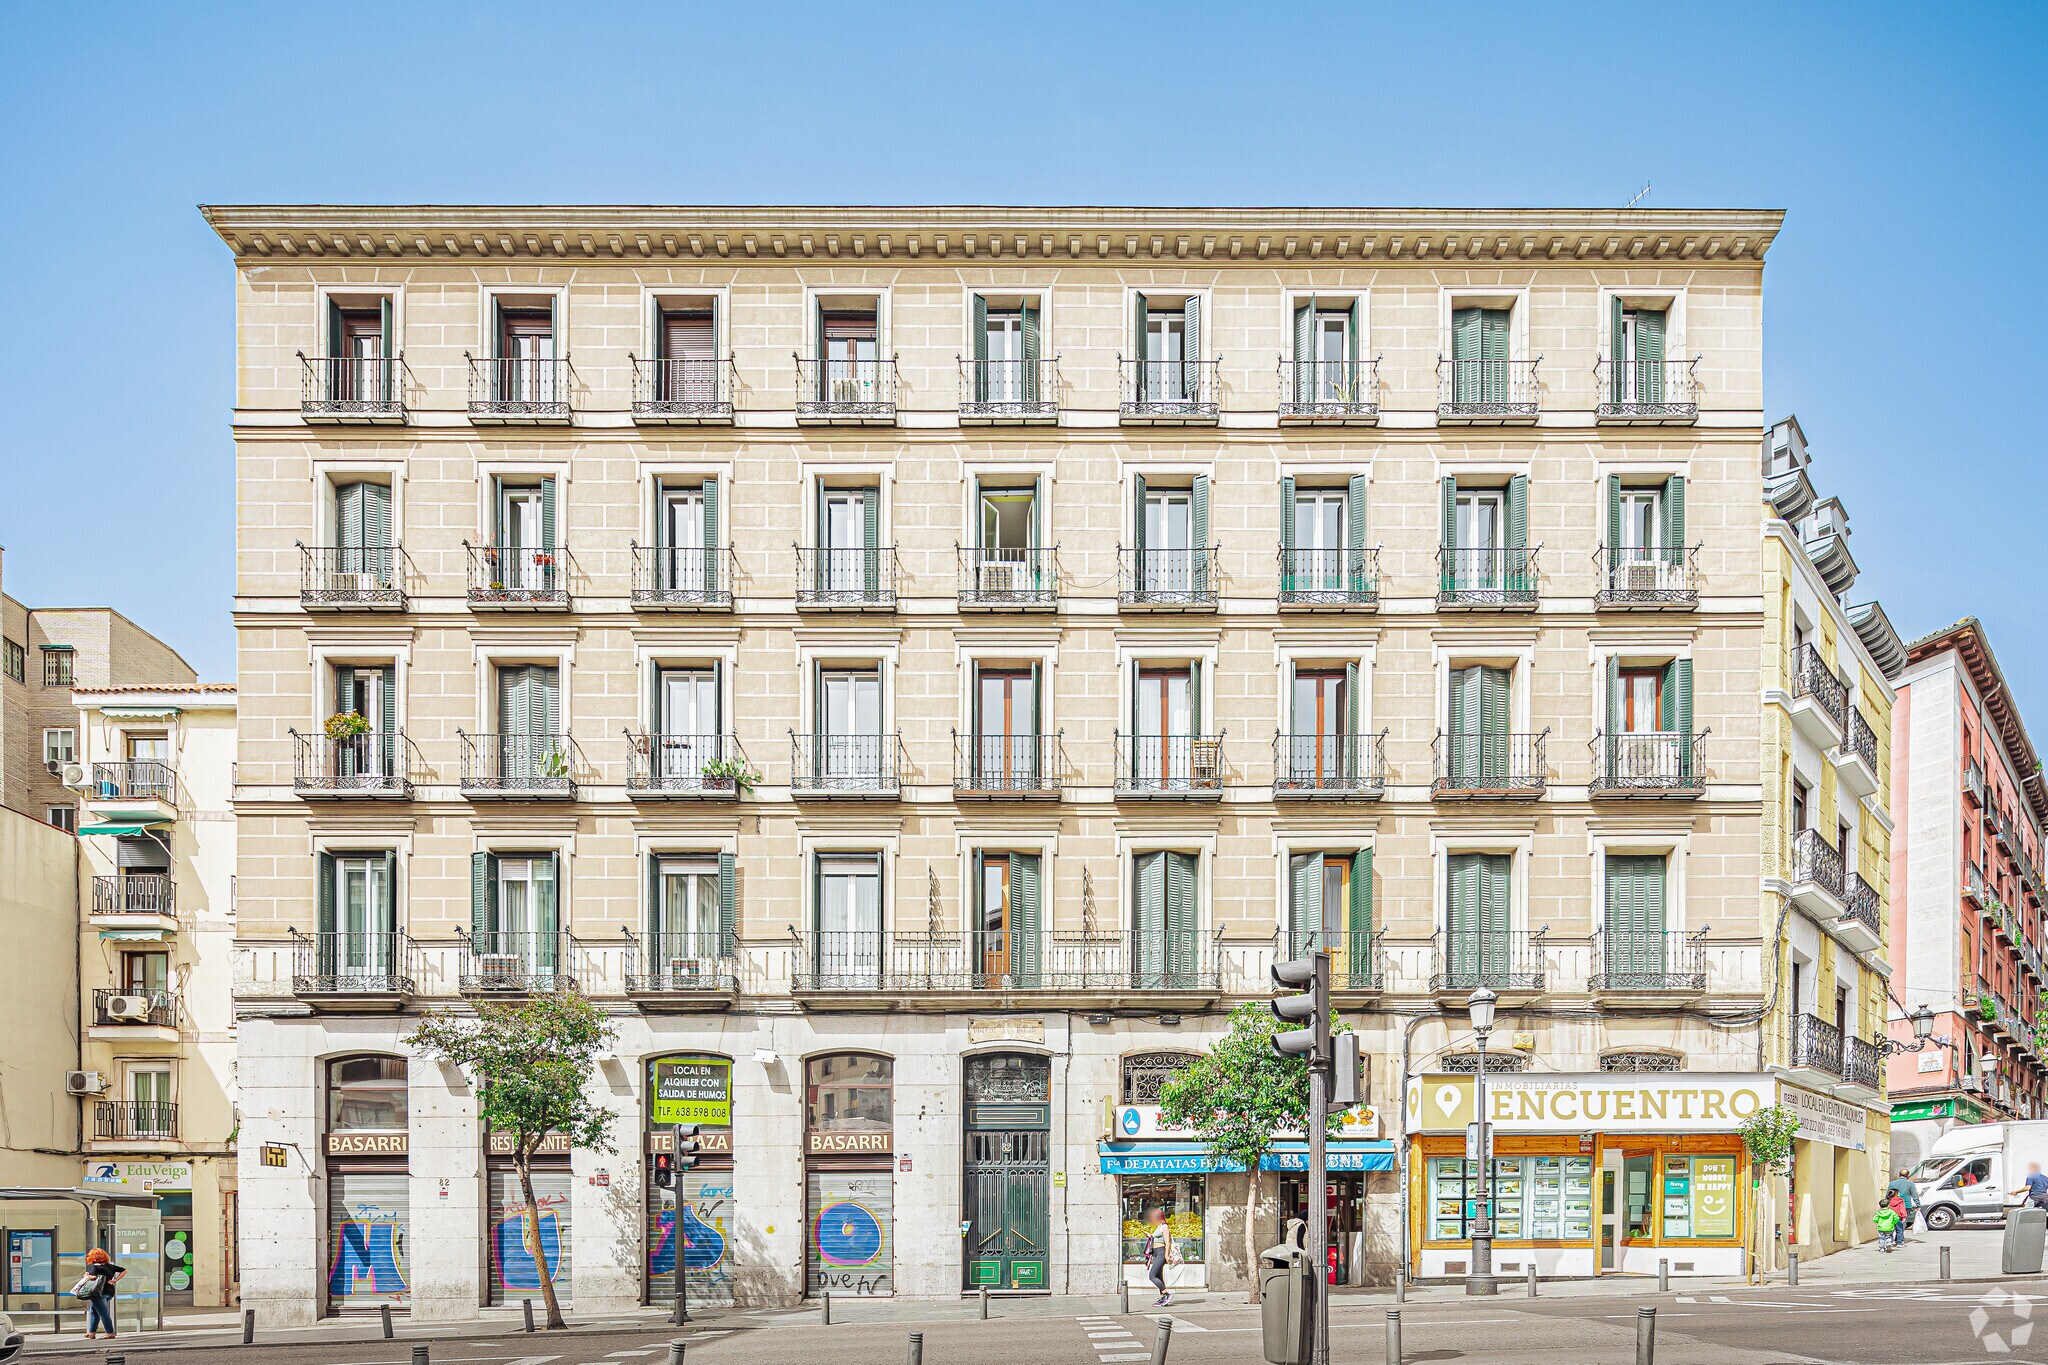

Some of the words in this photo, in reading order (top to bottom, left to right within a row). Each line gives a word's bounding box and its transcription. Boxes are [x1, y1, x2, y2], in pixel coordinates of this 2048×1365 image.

[673, 1066, 698, 1075] LOCAL
[700, 1067, 711, 1075] EN
[664, 1078, 699, 1087] ALQUILER
[701, 1079, 719, 1087] CON
[1491, 1081, 1578, 1090] INMOBILIARIAS
[658, 1090, 685, 1098] SALIDA
[687, 1090, 697, 1098] DE
[698, 1090, 726, 1099] HUMOS
[658, 1106, 673, 1116] TLF.
[675, 1107, 690, 1116] 638
[693, 1107, 709, 1117] 598
[711, 1108, 726, 1117] 008
[1491, 1089, 1760, 1120] ENCUENTRO
[1801, 1093, 1818, 1111] LOCAL
[1818, 1098, 1826, 1114] EN
[1825, 1101, 1840, 1118] VENTA
[1843, 1106, 1864, 1124] ALQUILER
[329, 1137, 407, 1151] BASARRI
[490, 1136, 568, 1151] RESTANTE
[651, 1135, 728, 1150] TEAZA
[811, 1135, 888, 1149] BASARRI
[1001, 1142, 1012, 1153] 82
[1124, 1160, 1141, 1169] DE
[1143, 1159, 1197, 1169] PATATAS
[1279, 1154, 1303, 1168] EL
[127, 1164, 188, 1180] EduVeiga
